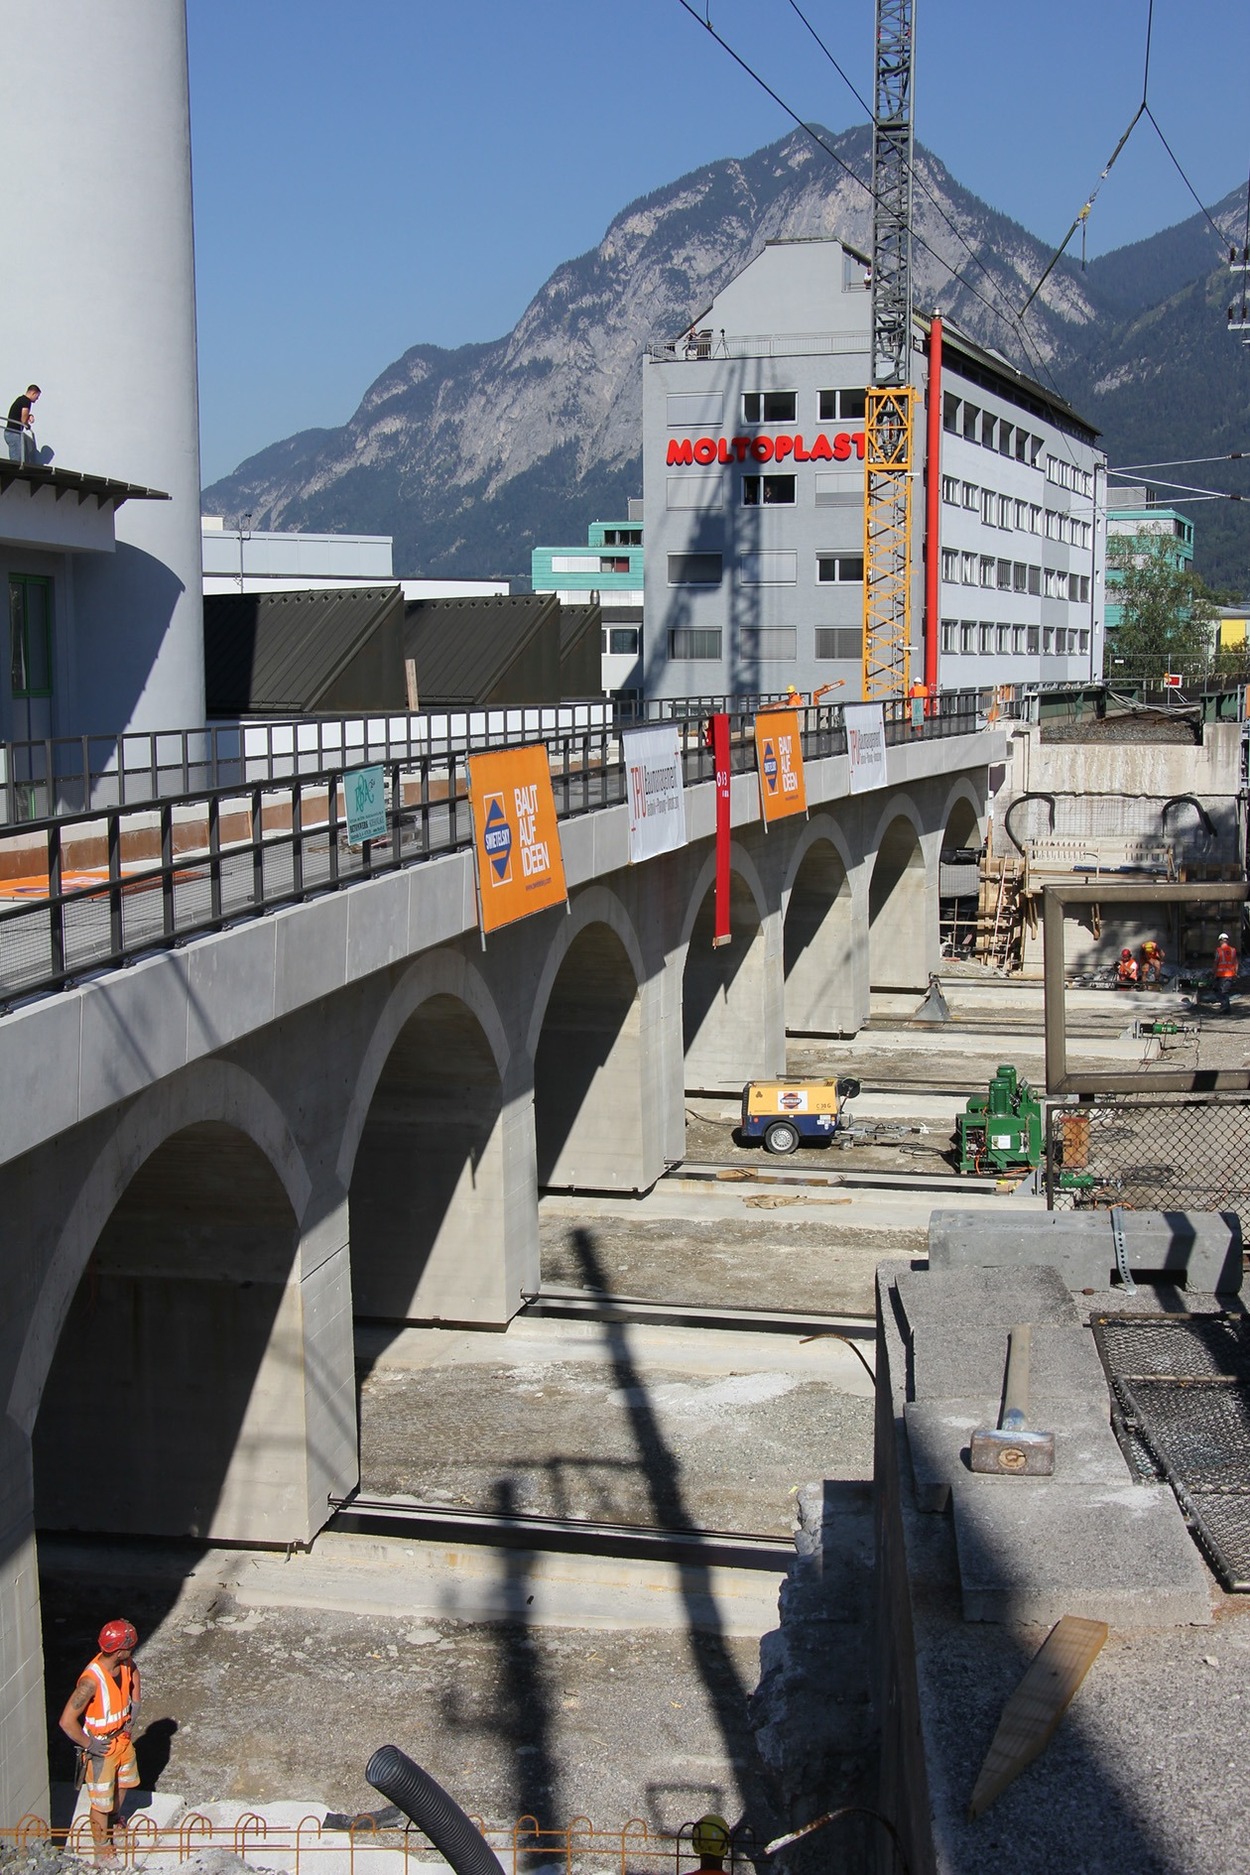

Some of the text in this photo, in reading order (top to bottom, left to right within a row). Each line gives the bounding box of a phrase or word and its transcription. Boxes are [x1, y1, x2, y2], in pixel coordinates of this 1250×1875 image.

[666, 432, 865, 466] MOLTOPLAST
[778, 735, 792, 755] BAUT
[781, 754, 791, 774] AUF
[630, 765, 646, 820] TPU
[782, 771, 798, 792] IDEEN
[514, 784, 539, 817] BAUT
[519, 815, 537, 847] AUF
[521, 841, 551, 877] IDEEN
